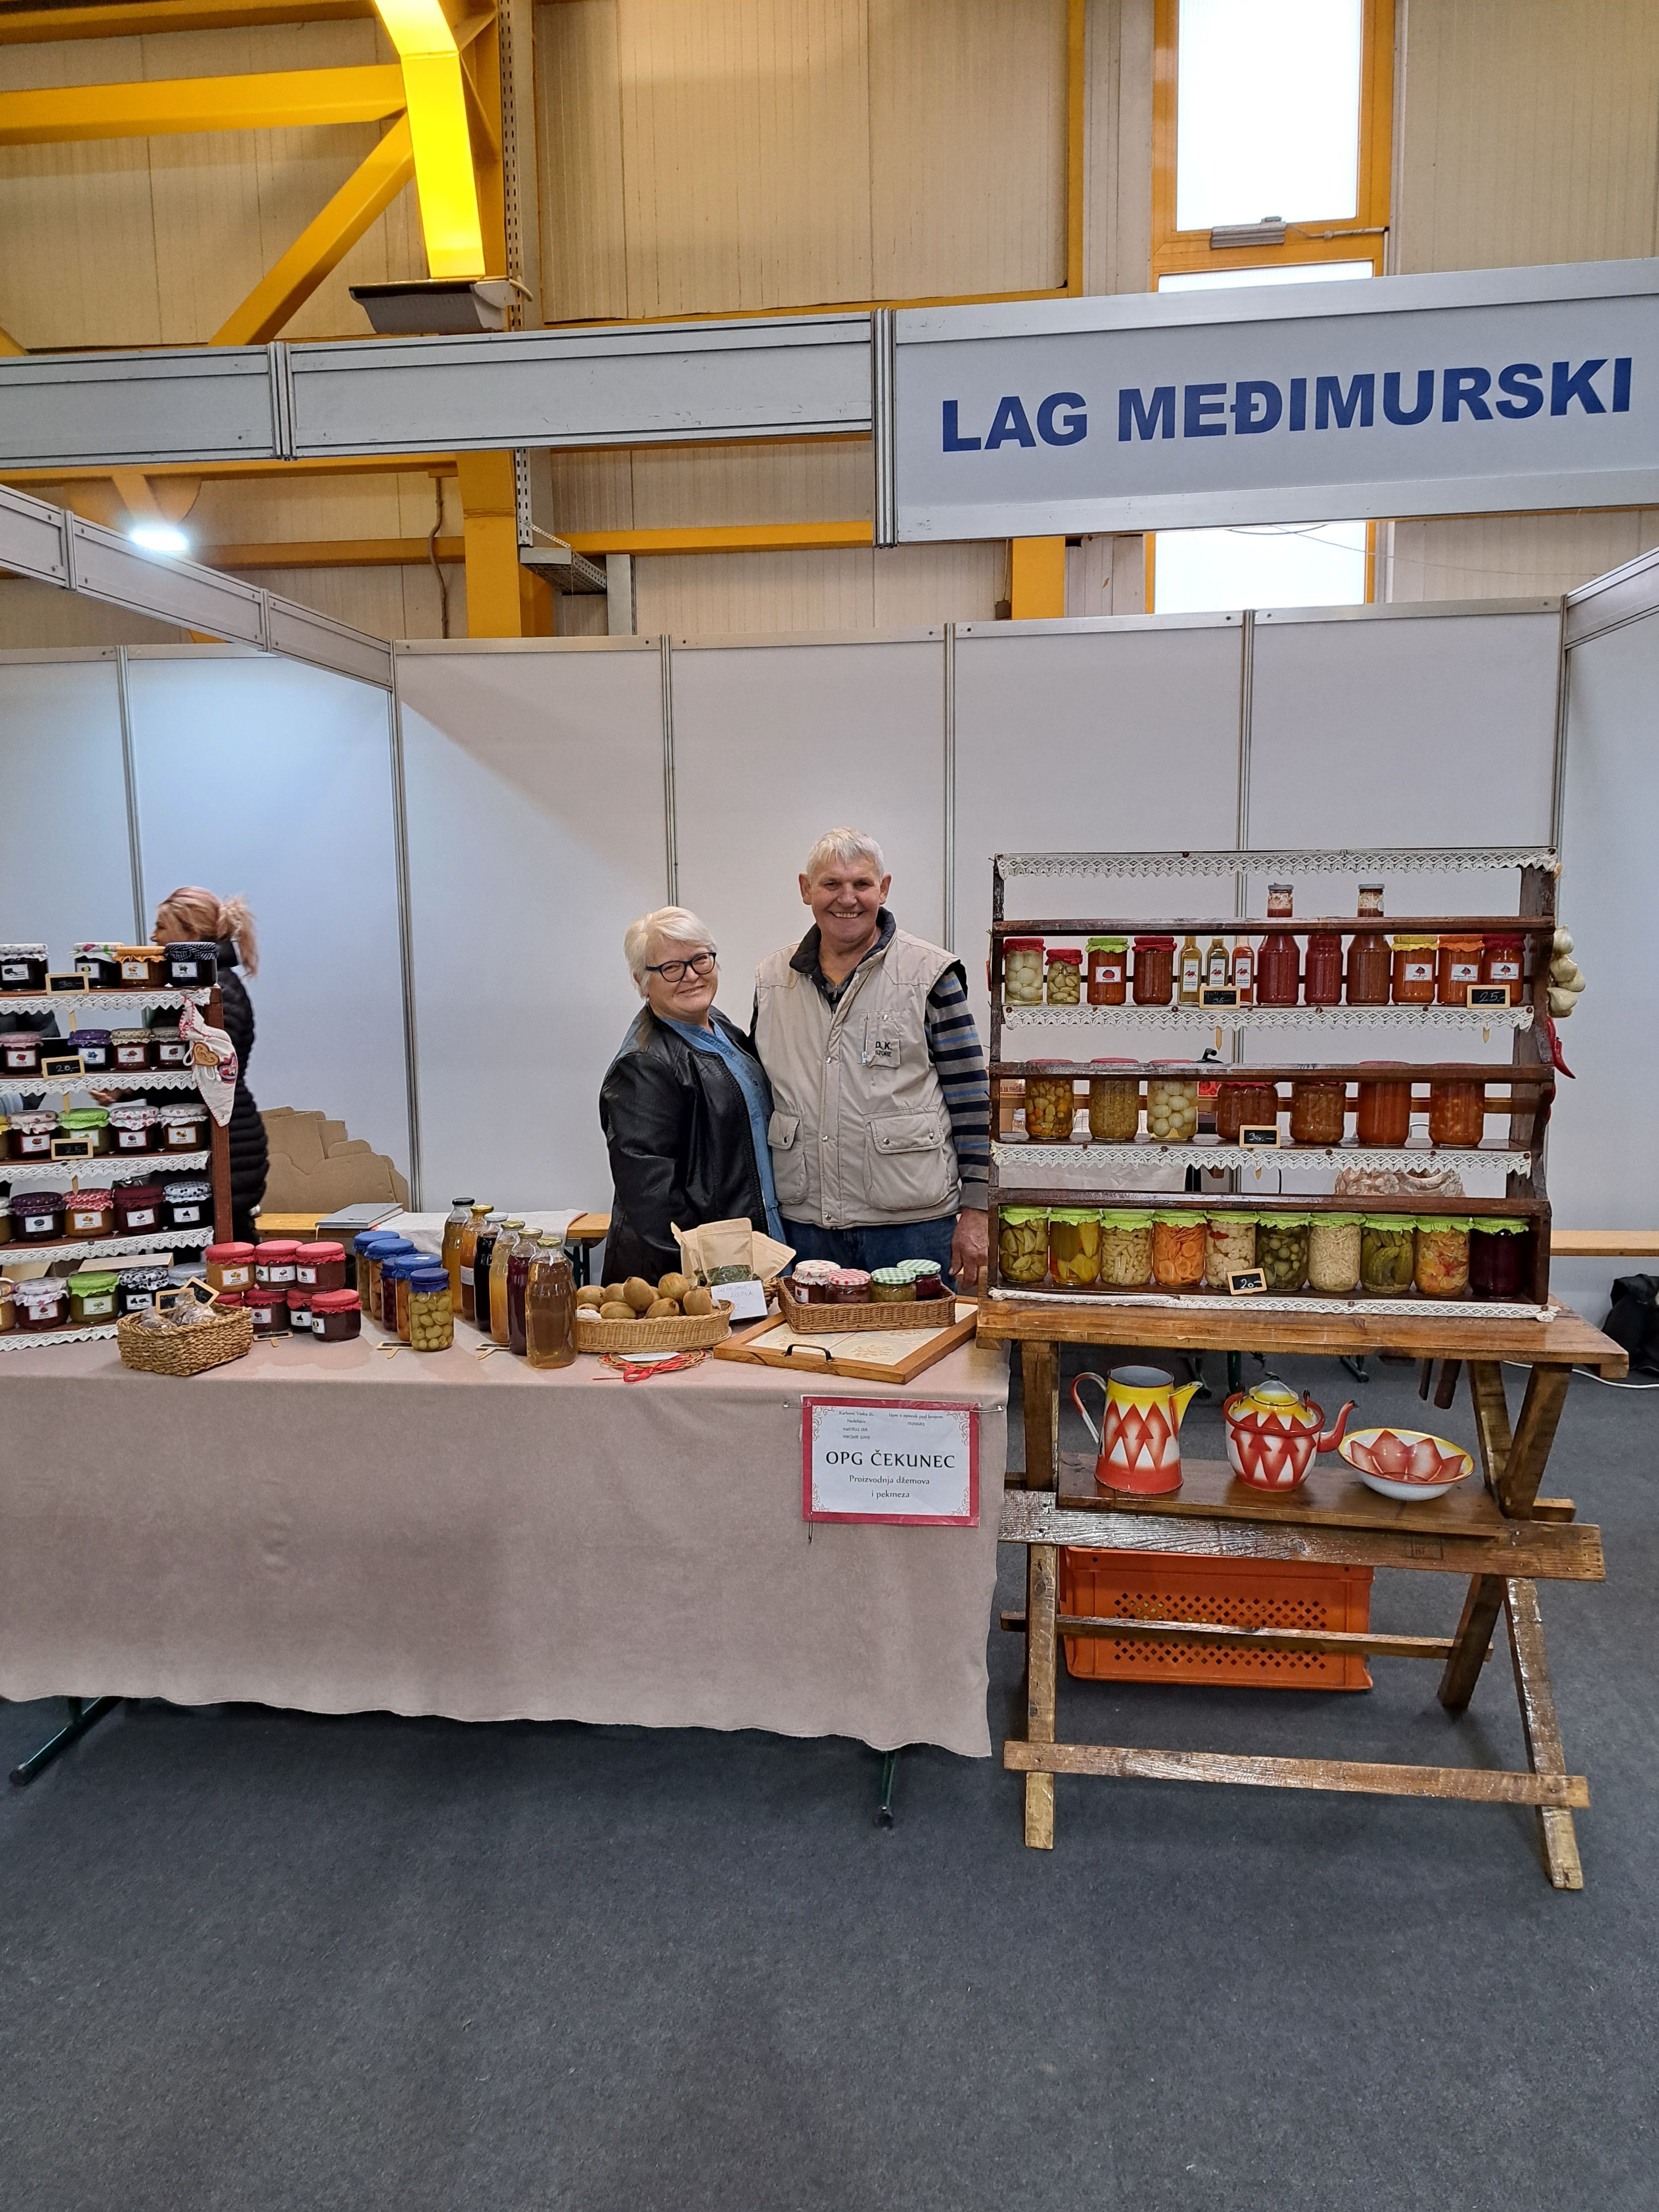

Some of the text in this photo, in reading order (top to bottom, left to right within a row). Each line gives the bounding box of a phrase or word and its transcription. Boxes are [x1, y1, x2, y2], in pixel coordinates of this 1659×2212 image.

[943, 357, 1632, 452] LAG MEĐIMURSKI
[826, 1449, 956, 1469] OPG ČEKUNEC
[849, 1474, 930, 1486] Proizvodnja džemova
[871, 1490, 910, 1500] i pekmeza
